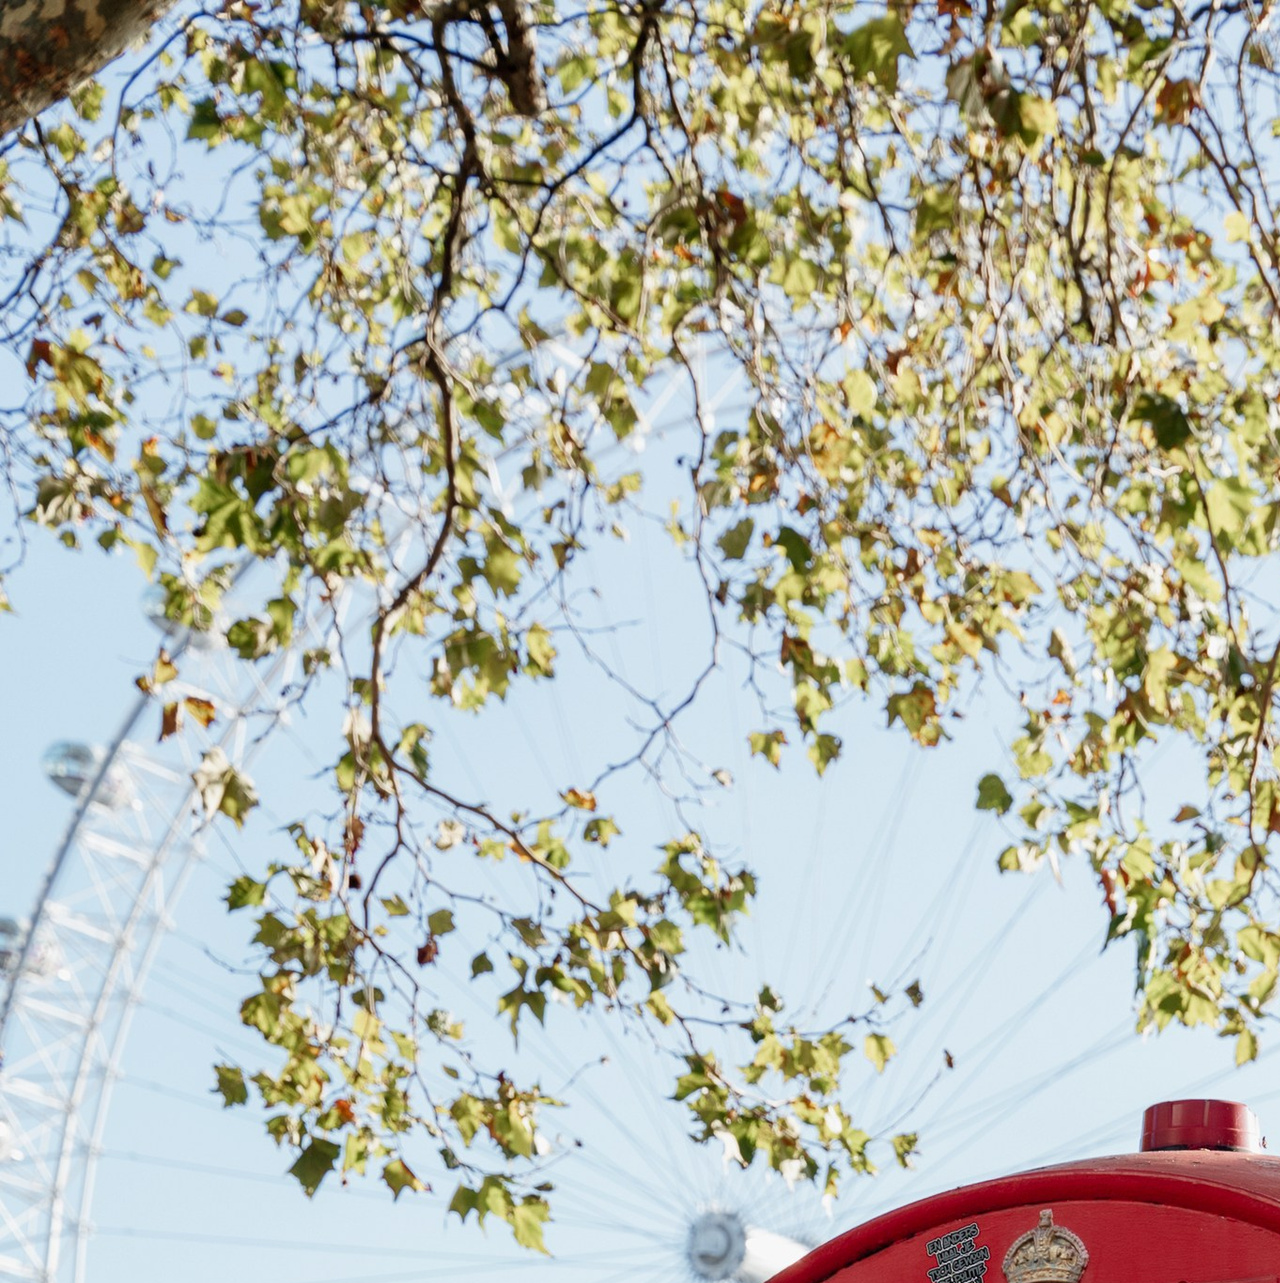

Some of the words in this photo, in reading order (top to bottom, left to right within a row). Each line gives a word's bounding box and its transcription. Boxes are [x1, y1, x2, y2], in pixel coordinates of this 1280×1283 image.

[927, 1239, 942, 1254] EN
[943, 1224, 979, 1249] ANDERS
[961, 1240, 974, 1255] JE
[928, 1263, 952, 1282] TOCH
[952, 1247, 989, 1271] GEWOON
